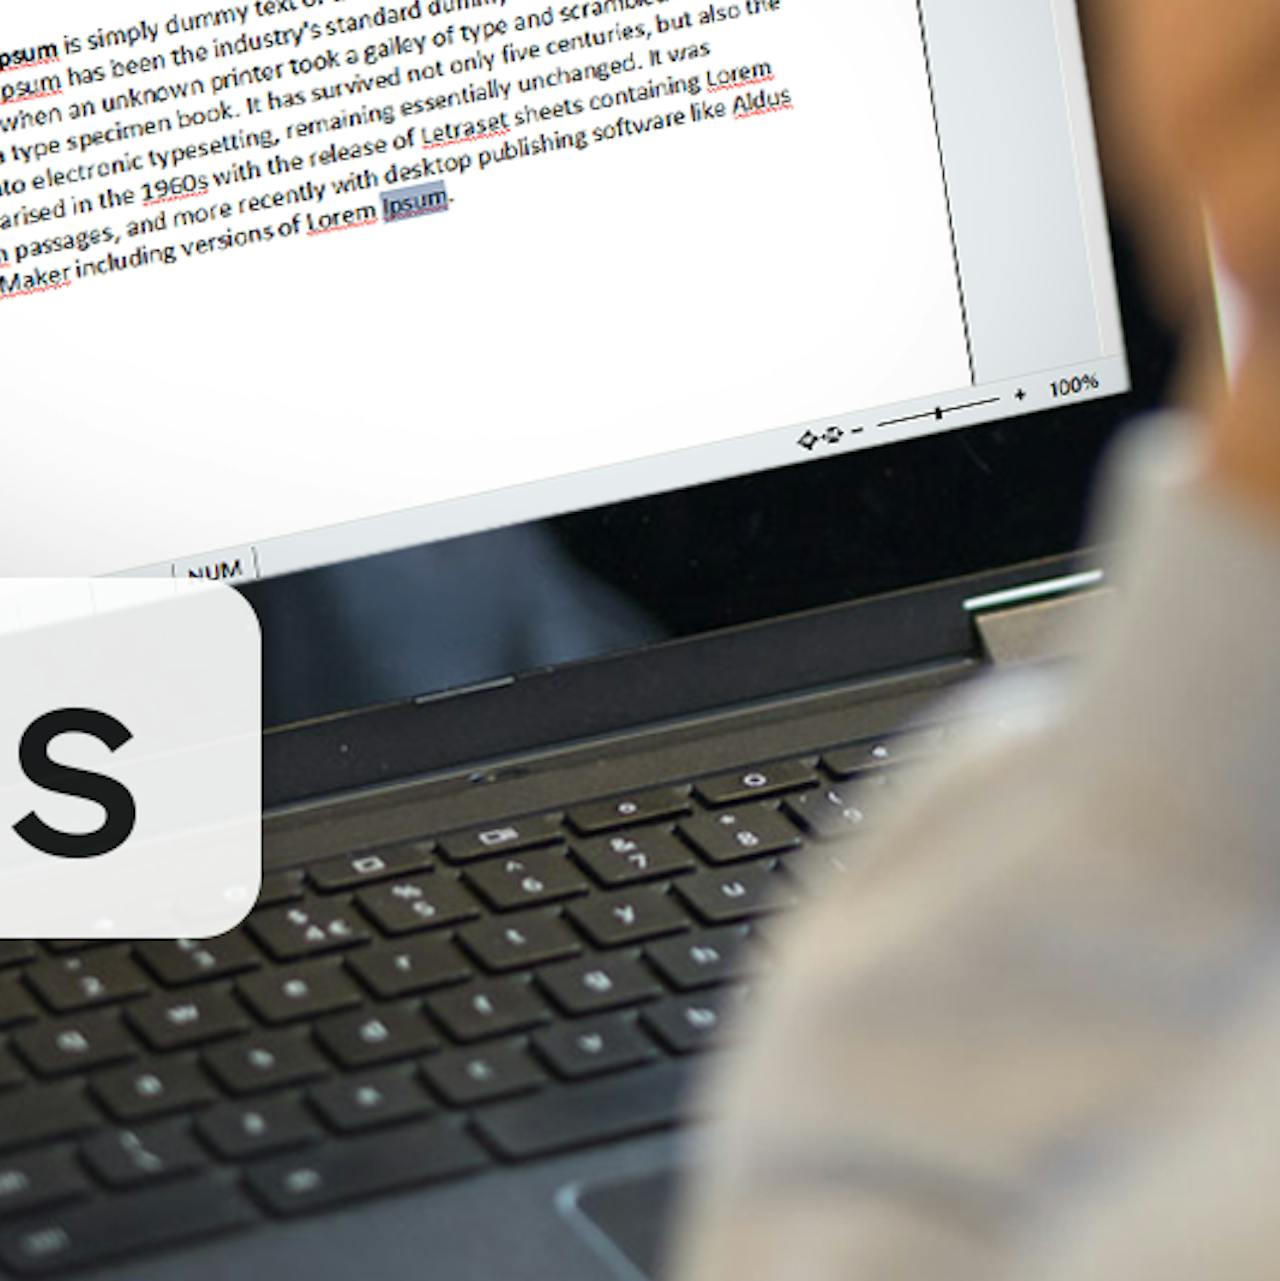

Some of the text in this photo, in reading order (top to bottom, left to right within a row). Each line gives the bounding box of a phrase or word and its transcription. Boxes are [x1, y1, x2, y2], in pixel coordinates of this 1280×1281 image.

[11, 140, 61, 164] type
[66, 118, 173, 153] specimen
[176, 100, 240, 129] book.
[246, 97, 262, 115] It
[267, 90, 307, 111] has
[311, 65, 402, 101] survived
[407, 60, 445, 83] not
[449, 50, 495, 75] only
[502, 42, 541, 65] five
[545, 22, 653, 56] centuries,
[655, 11, 693, 34] but
[699, 3, 742, 25] also
[63, 34, 82, 55] is
[87, 20, 159, 51] simply
[165, 5, 249, 35] dummy
[67, 65, 106, 87] has
[110, 54, 166, 78] been
[170, 44, 209, 67] the
[212, 20, 323, 58] industry's
[325, 0, 422, 36] standard
[68, 100, 96, 120] an
[102, 79, 205, 113] unknown
[211, 63, 284, 94] printer
[288, 49, 341, 76] took
[346, 49, 360, 65] a
[363, 35, 427, 66] galley
[431, 24, 455, 48] of
[459, 18, 508, 45] type
[514, 6, 555, 32] and
[31, 152, 144, 190] electronic
[148, 129, 281, 170] typesetting,
[286, 105, 396, 139] remaining
[400, 78, 511, 117] essentially
[518, 51, 643, 93] unchanged.
[649, 49, 663, 67] It
[667, 42, 711, 63] was
[71, 196, 93, 215] in
[98, 188, 135, 209] the
[140, 173, 210, 202] 1960s
[212, 160, 262, 187] with
[267, 154, 305, 176] the
[309, 139, 388, 168] release
[392, 126, 415, 151] of
[420, 111, 511, 145] Letraset
[514, 99, 585, 127] sheets
[589, 75, 703, 111] containing
[706, 61, 773, 87] Lorem
[15, 226, 120, 264] passages,
[126, 210, 167, 238] and
[173, 202, 233, 227] more
[238, 180, 326, 213] recently
[331, 169, 379, 195] with
[384, 153, 473, 185] desktop
[478, 130, 589, 171] publishing
[592, 110, 686, 142] software
[690, 101, 727, 123] like
[732, 88, 793, 115] Aldus
[75, 245, 178, 279] including
[180, 225, 276, 257] versions
[277, 212, 301, 238] of
[305, 204, 377, 232] Lorem
[382, 189, 454, 219] Ipsum.
[1050, 373, 1100, 398] 100%
